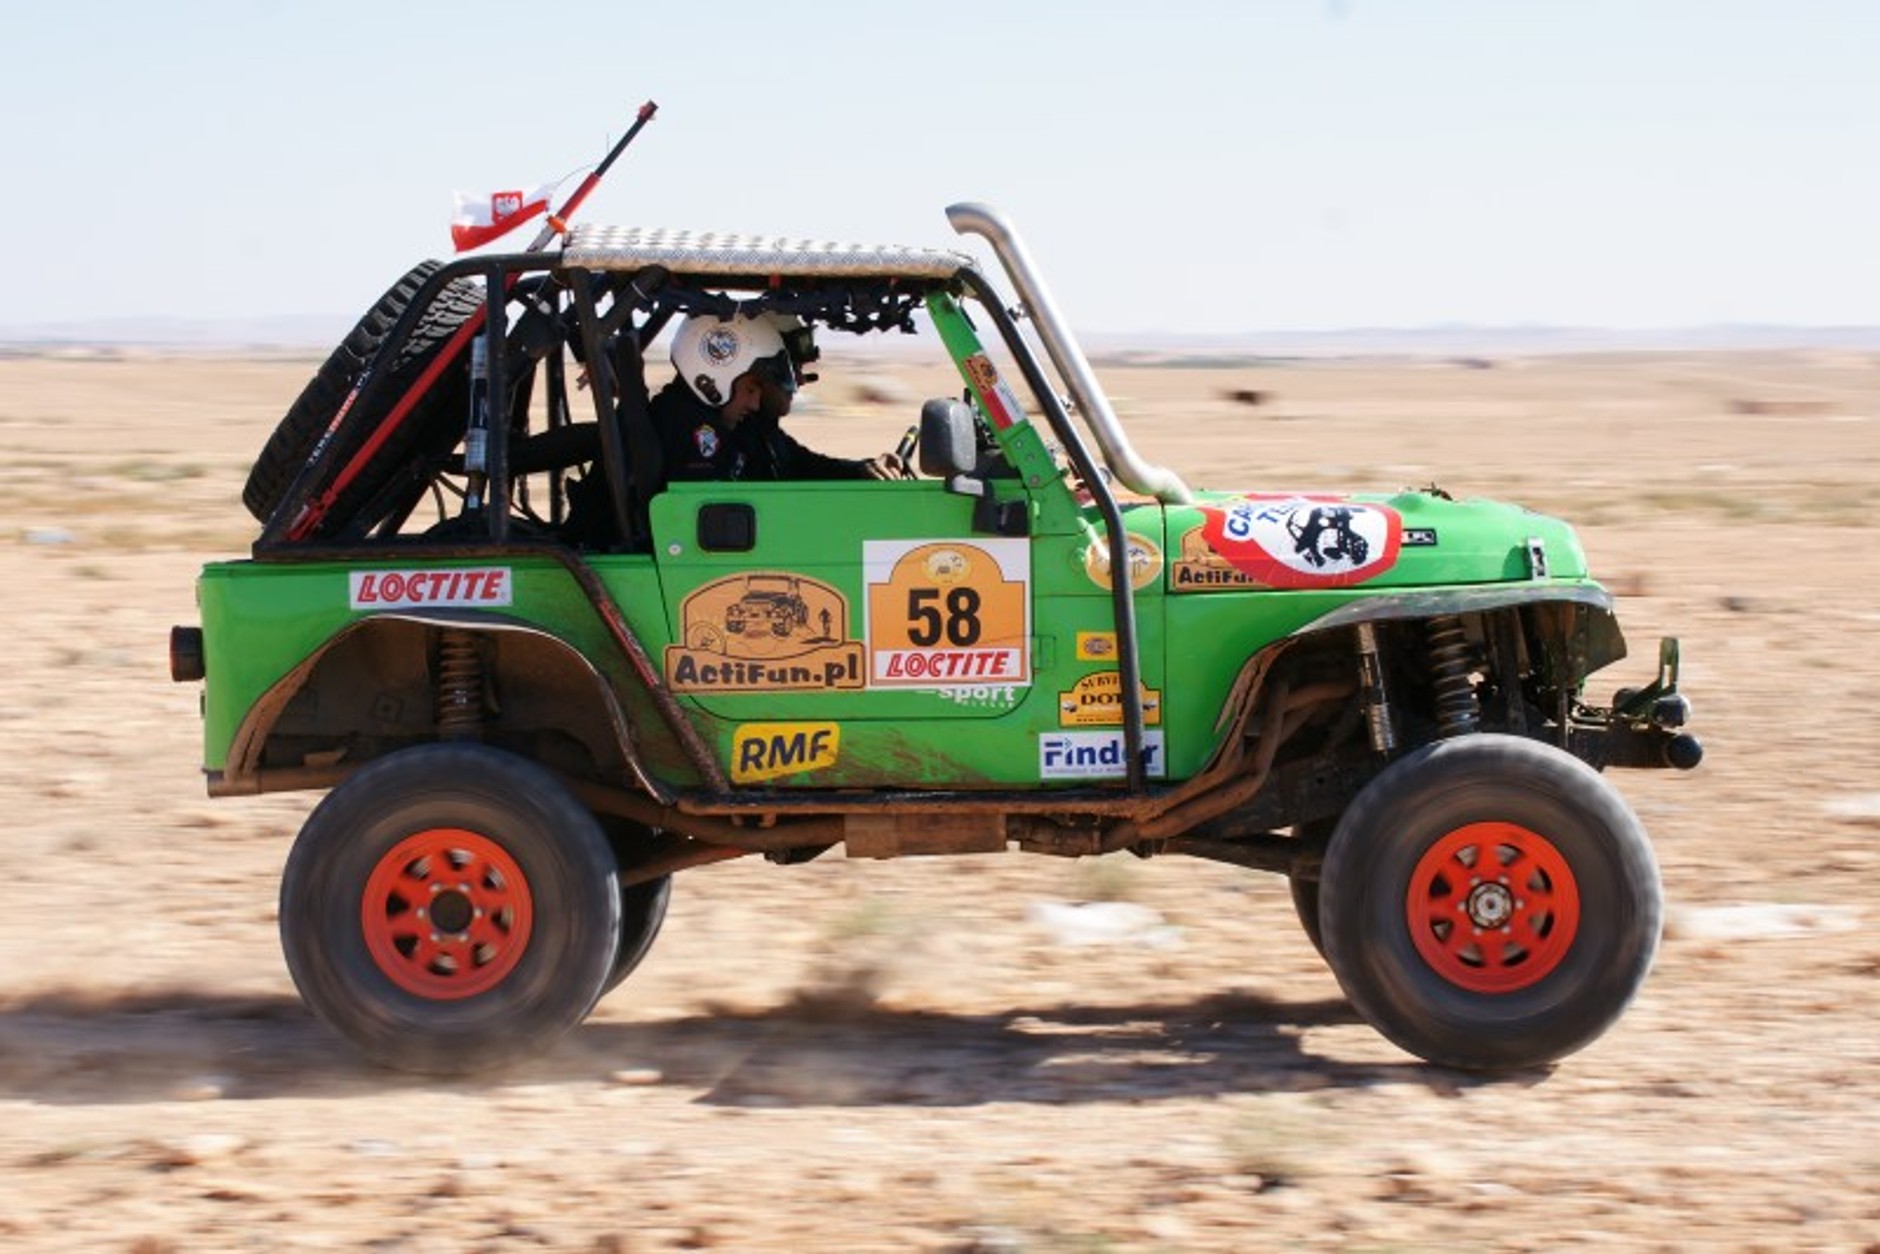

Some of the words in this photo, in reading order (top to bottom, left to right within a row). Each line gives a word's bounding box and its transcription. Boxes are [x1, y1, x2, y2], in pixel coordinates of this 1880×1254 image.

[357, 571, 505, 602] LOCTITE
[1178, 566, 1254, 583] ActiFu
[907, 586, 981, 647] 58
[674, 651, 858, 688] ActiFun.pl
[886, 650, 1009, 678] LOCTITE
[938, 685, 1014, 703] sport
[740, 730, 831, 773] RMF
[1044, 739, 1159, 766] Findr
